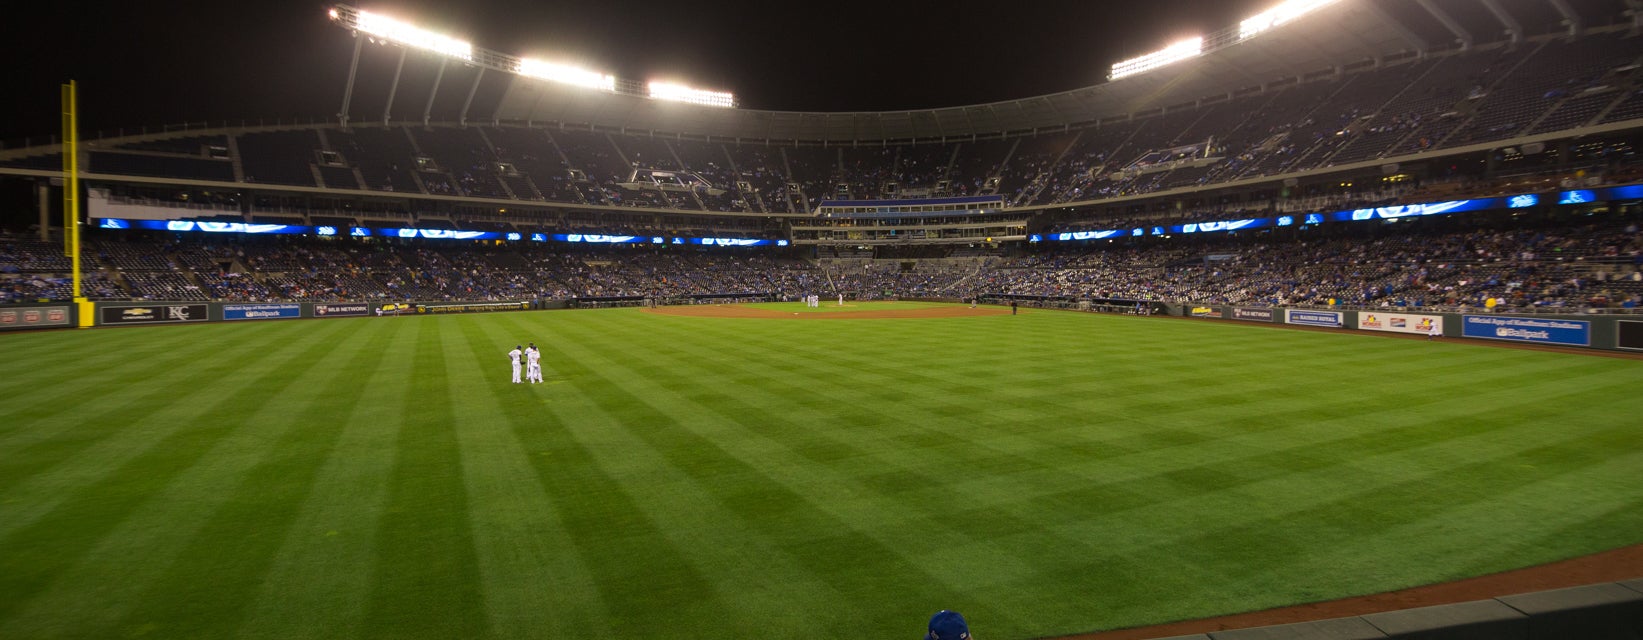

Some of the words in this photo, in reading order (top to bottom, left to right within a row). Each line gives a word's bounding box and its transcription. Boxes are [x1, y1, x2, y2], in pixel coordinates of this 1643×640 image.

[1492, 318, 1505, 326] App
[1550, 321, 1582, 329] Stadium
[1507, 328, 1549, 339] Ballpark
